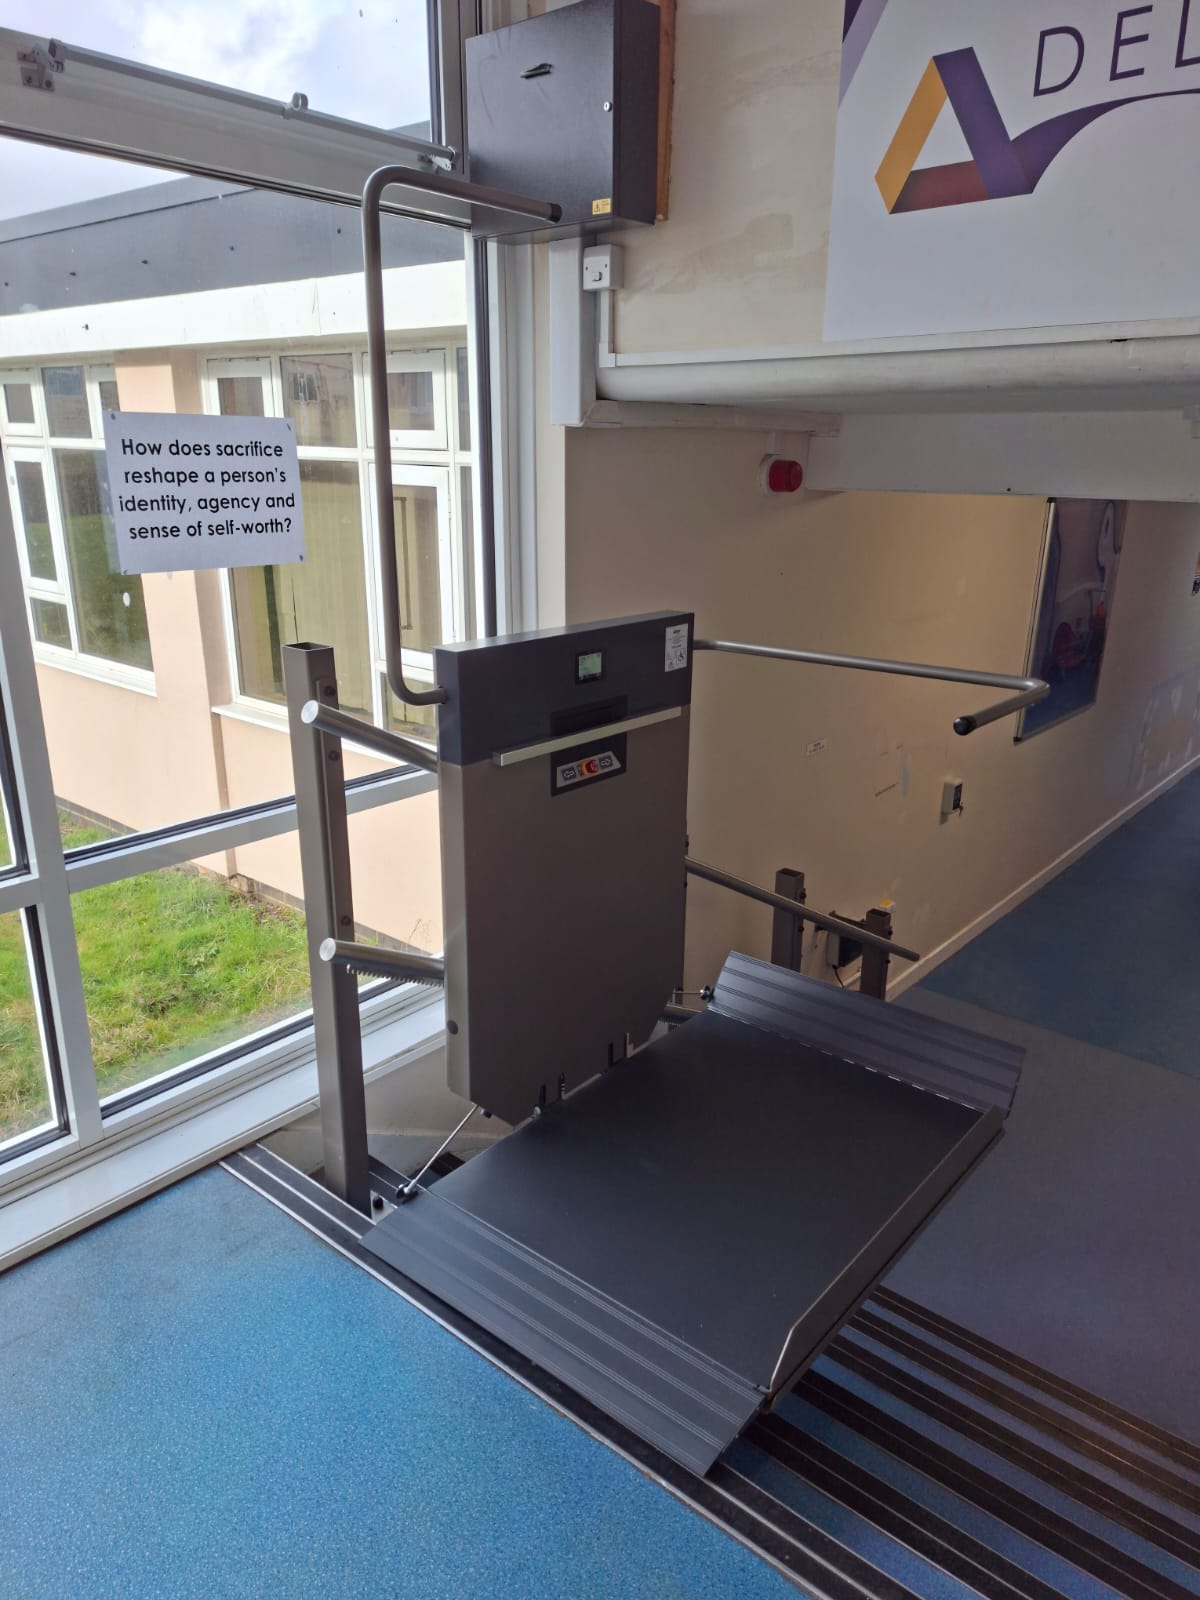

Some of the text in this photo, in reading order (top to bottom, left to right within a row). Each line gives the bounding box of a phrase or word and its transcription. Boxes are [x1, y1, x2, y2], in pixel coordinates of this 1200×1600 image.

[121, 439, 284, 457] How does sacrifice
[124, 467, 287, 487] reshape a person's
[119, 493, 295, 514] identity, agency and
[129, 517, 292, 540] sense of self-worth?
